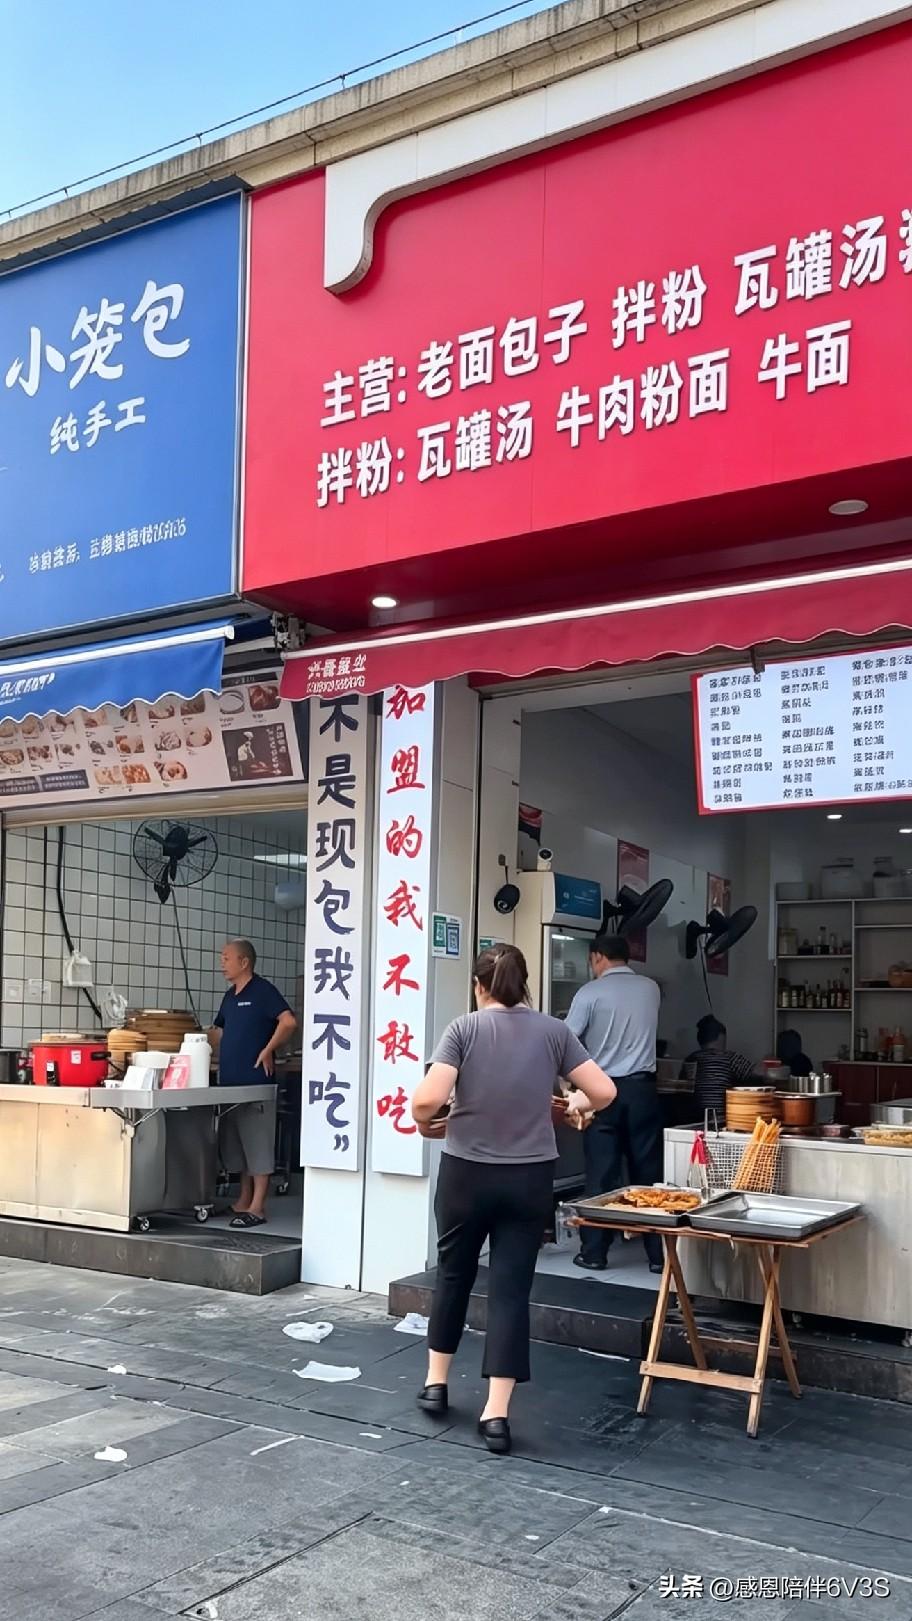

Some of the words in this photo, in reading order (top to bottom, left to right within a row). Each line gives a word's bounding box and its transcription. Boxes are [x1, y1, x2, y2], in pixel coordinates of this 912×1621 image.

[5, 280, 190, 397] 小笼包
[611, 264, 707, 348] 拌粉
[734, 208, 912, 316] 瓦罐汤
[49, 396, 146, 454] 纯手工
[556, 348, 730, 447] 牛肉粉面
[757, 319, 852, 400] 牛面
[377, 685, 427, 1135] 加盟的我不敢吃
